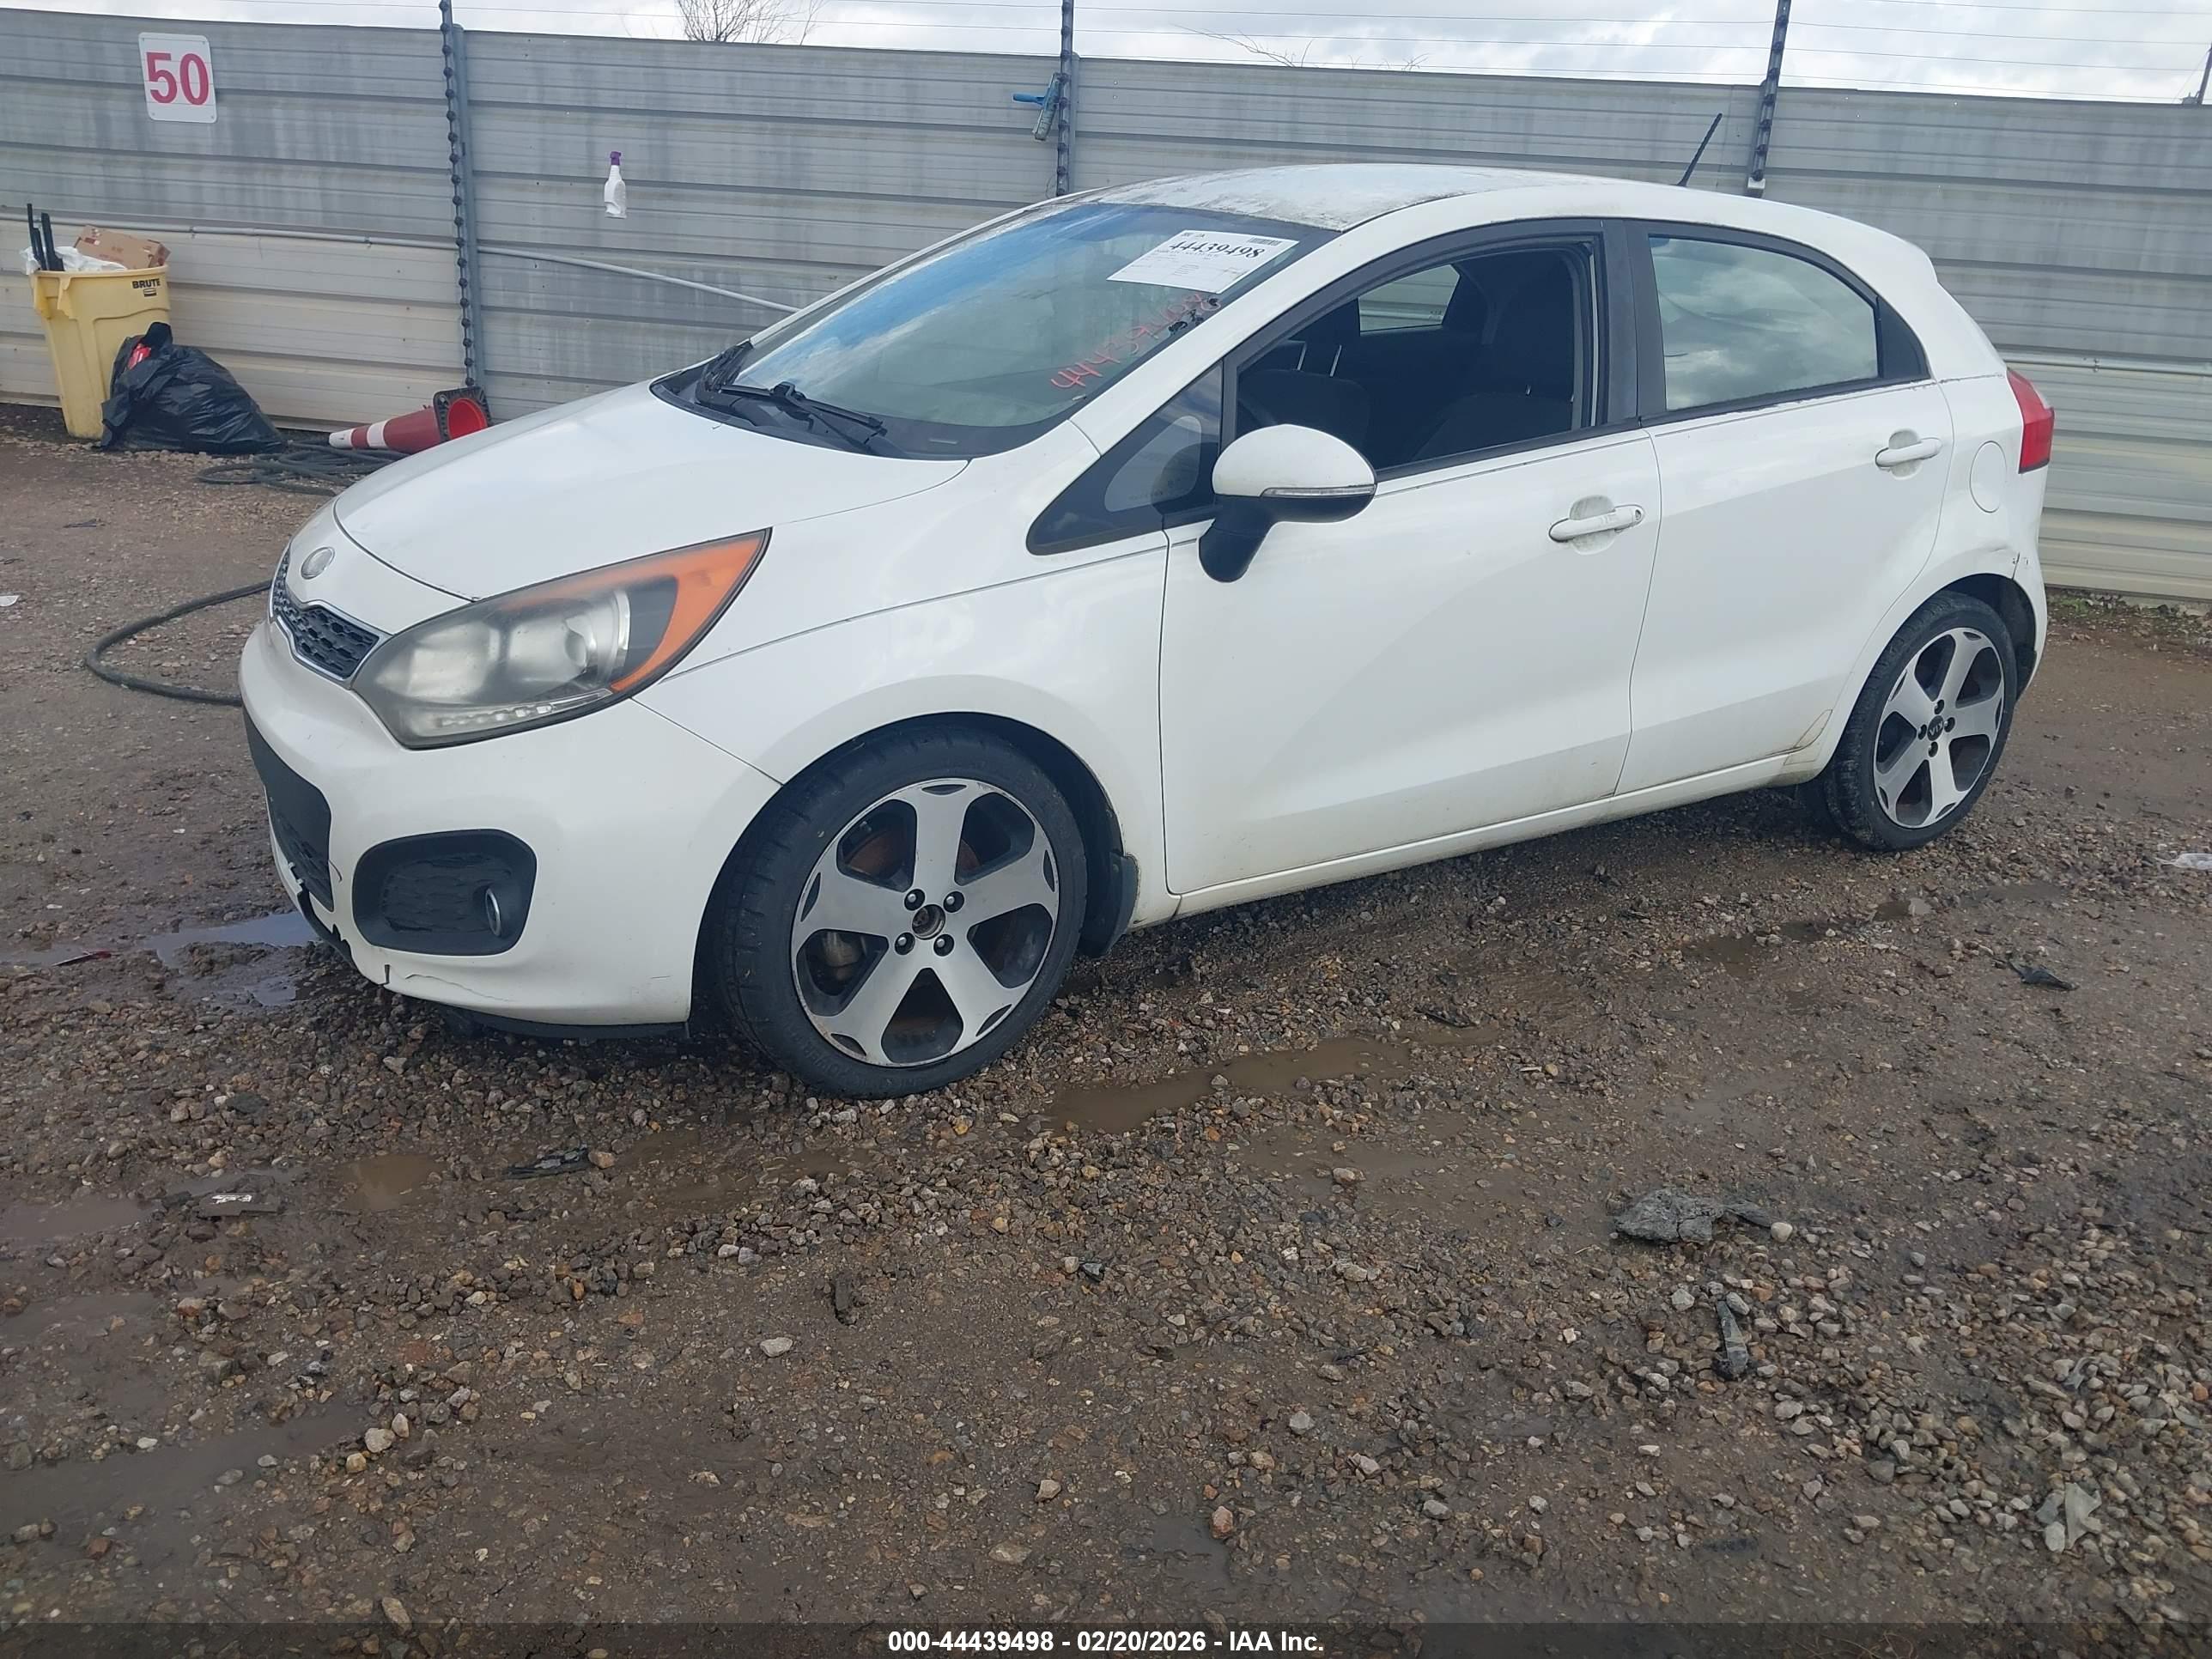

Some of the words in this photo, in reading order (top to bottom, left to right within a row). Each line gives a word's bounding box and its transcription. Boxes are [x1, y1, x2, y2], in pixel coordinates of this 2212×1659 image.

[146, 52, 210, 106] 50
[1170, 240, 1266, 258] 44439498
[131, 278, 161, 289] BRUTE
